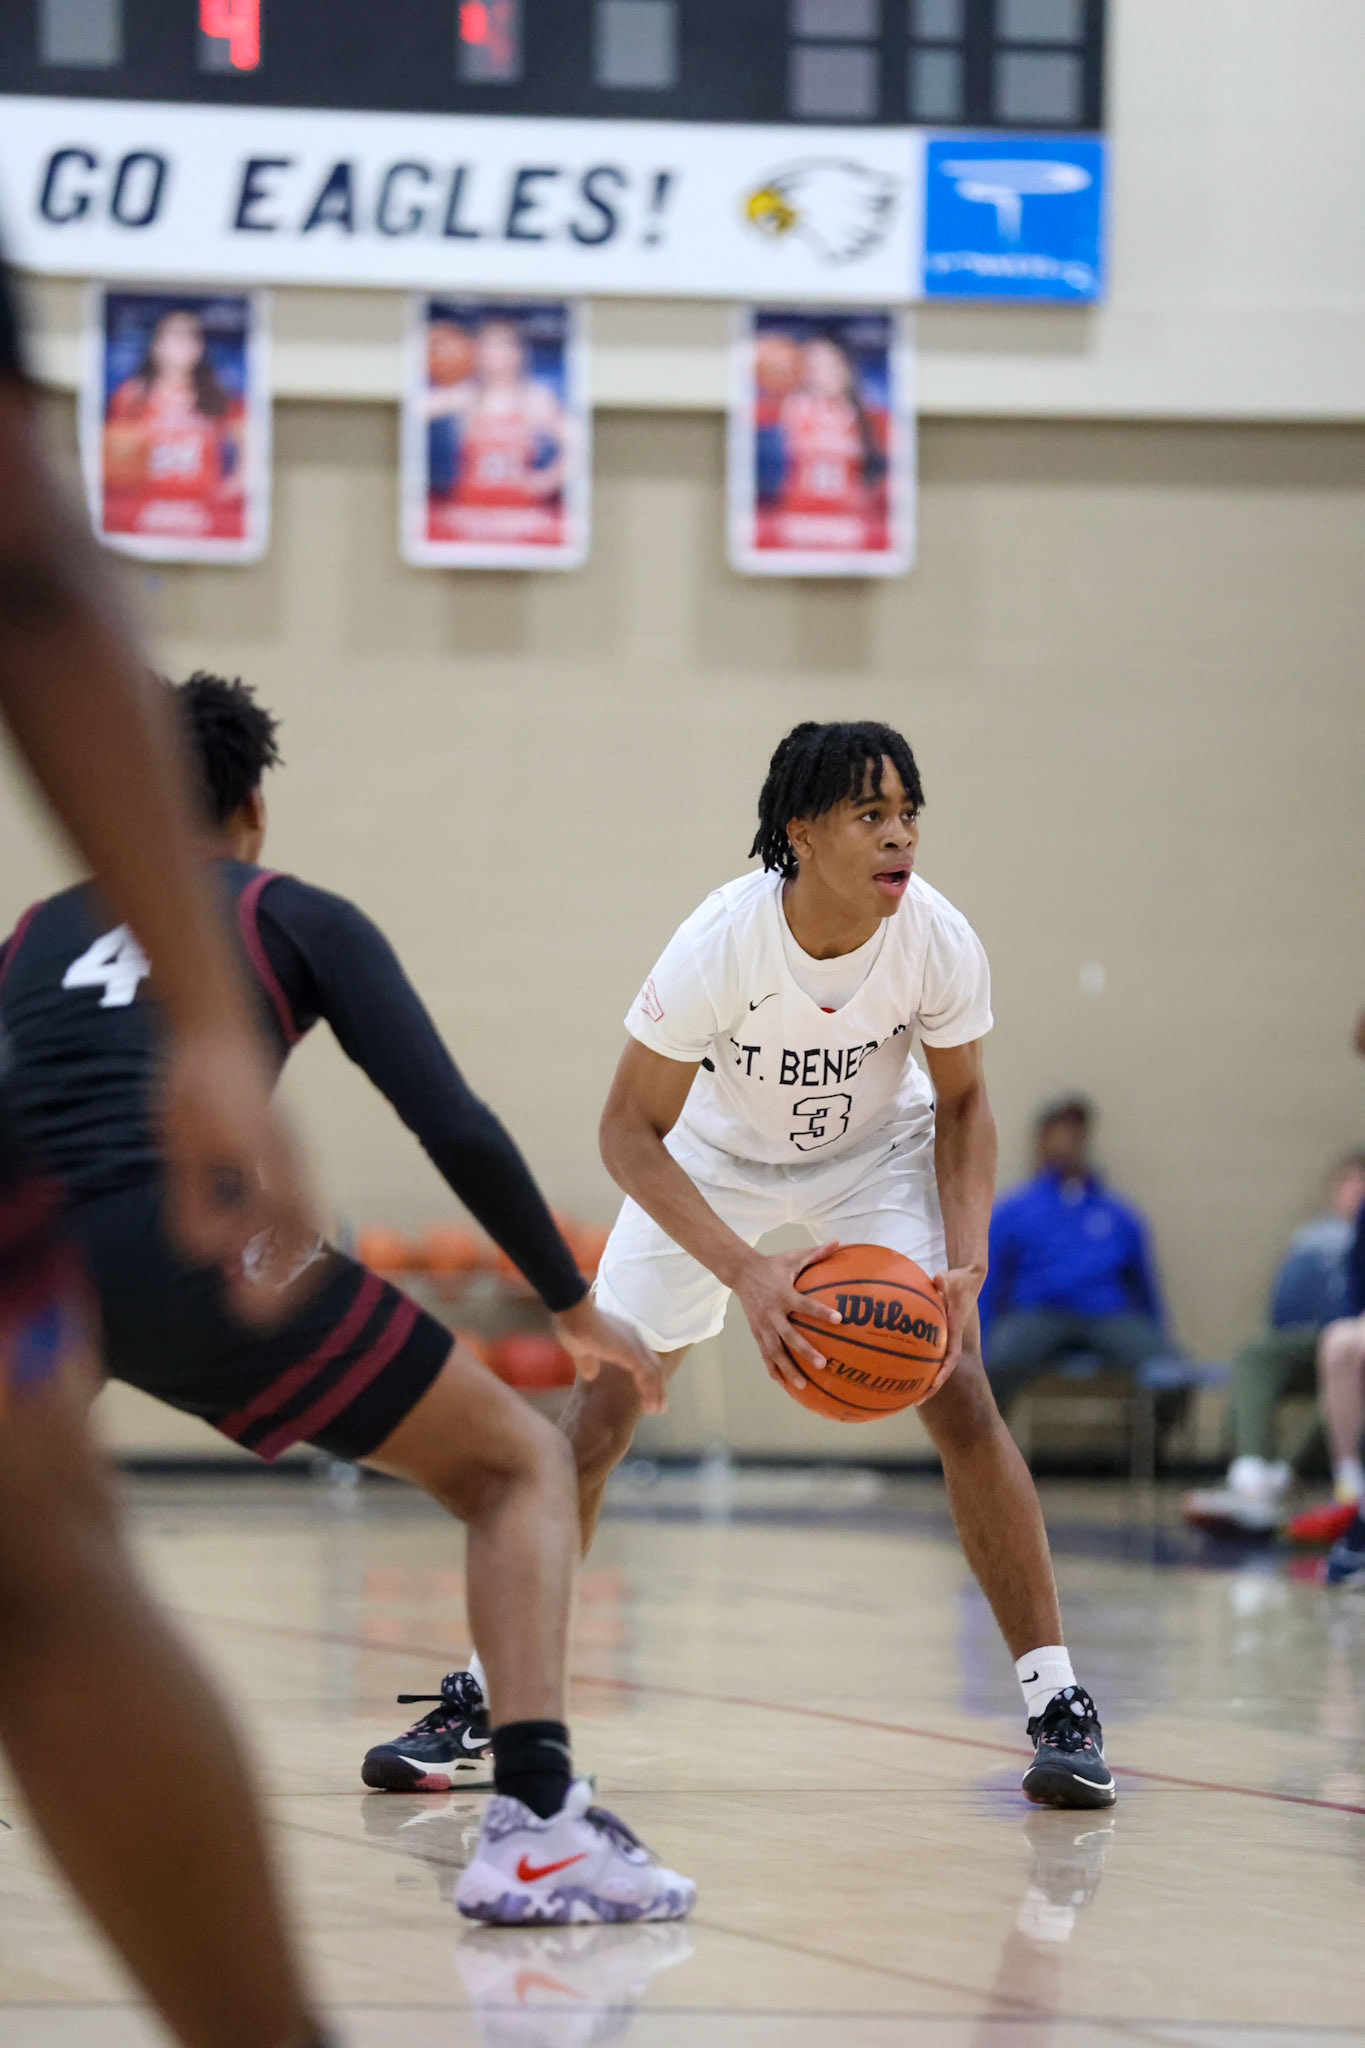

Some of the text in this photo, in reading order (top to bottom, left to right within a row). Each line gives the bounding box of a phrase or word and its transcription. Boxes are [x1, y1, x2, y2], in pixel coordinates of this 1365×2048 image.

[38, 145, 678, 247] GO EAGLES!
[62, 923, 151, 1008] 4
[790, 1093, 852, 1151] 3
[835, 1293, 940, 1349] Wilson
